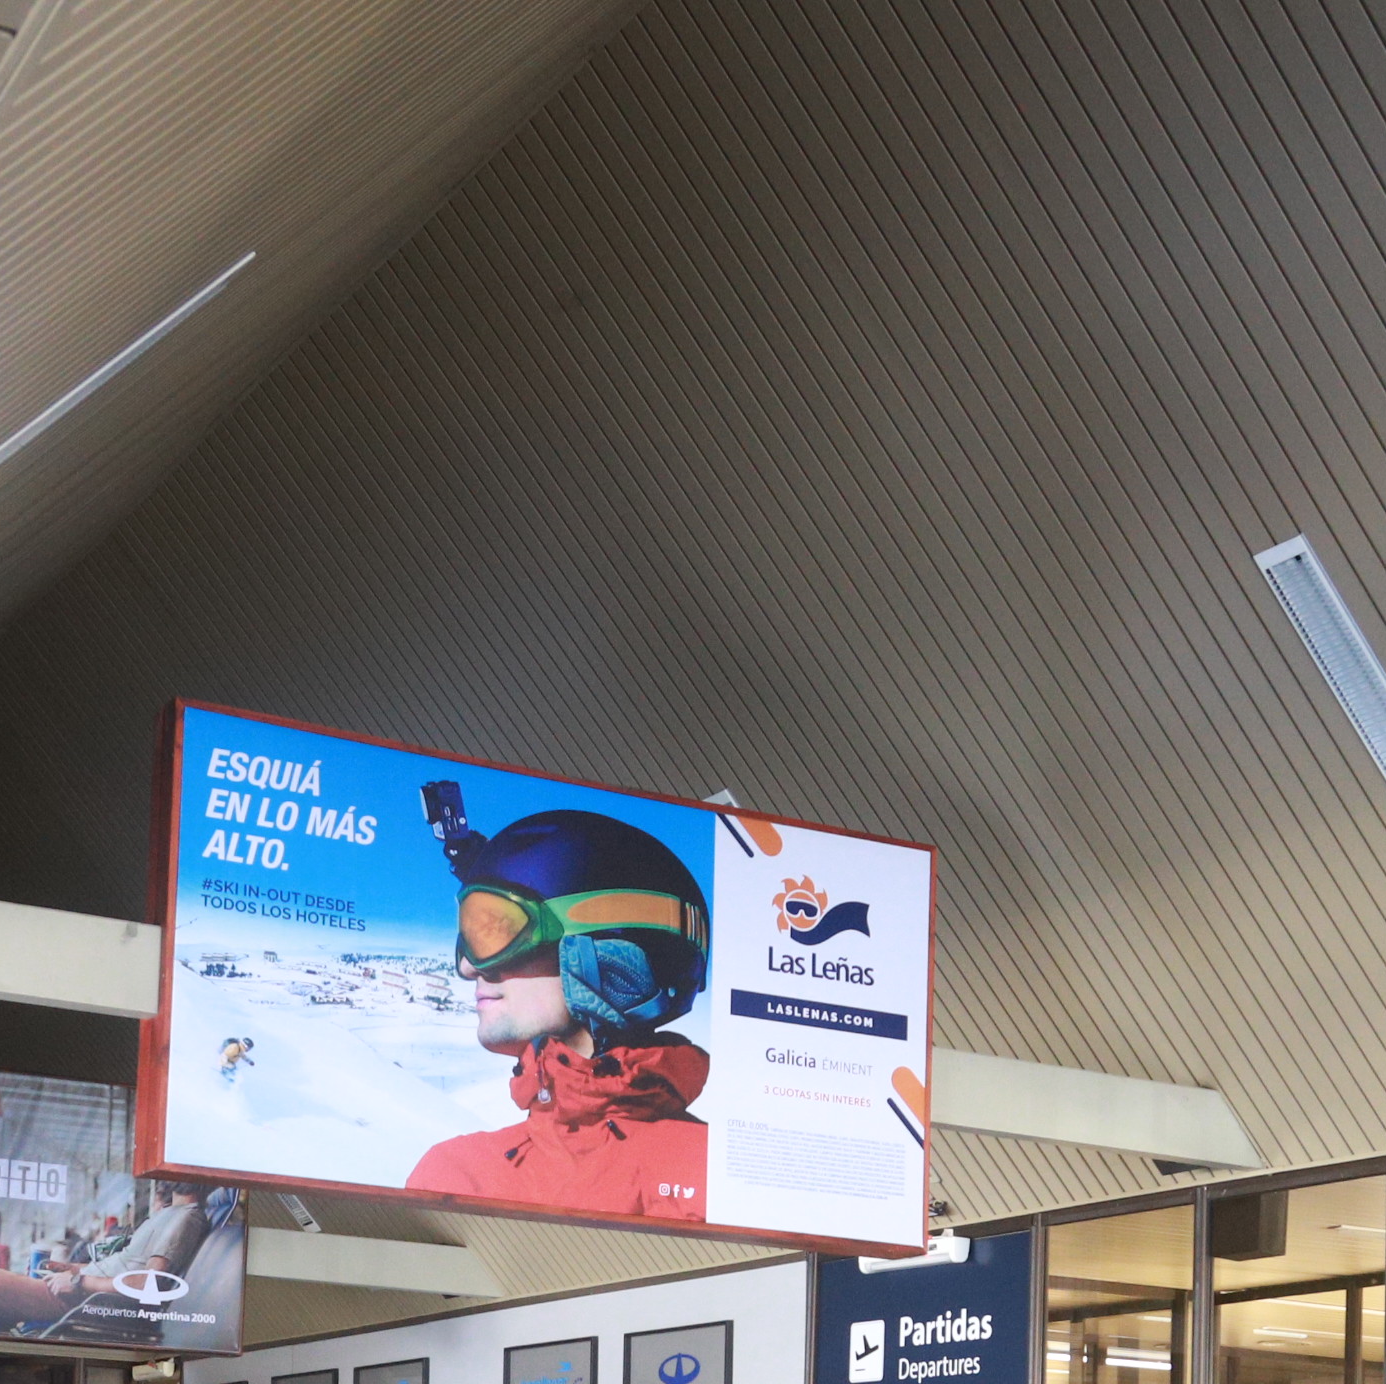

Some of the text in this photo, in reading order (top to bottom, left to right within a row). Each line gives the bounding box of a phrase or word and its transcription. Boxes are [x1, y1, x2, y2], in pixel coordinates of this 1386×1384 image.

[206, 747, 322, 798] ESQUIÁ
[205, 788, 378, 846] EN LO MÁS
[202, 829, 290, 871] ALTO.
[201, 893, 366, 932] TODOS LOS HOTELES
[202, 877, 355, 914] #SKI IN-OUT DESDE
[768, 946, 875, 986] Las Leñas
[767, 1002, 874, 1028] LASLENAS.COM
[765, 1047, 874, 1077] Galicia ÉMINENT
[764, 1085, 872, 1108] 3 CUOTAS SIN INTERÉS
[82, 1304, 216, 1324] Aeropuertos Argentina 2000
[899, 1308, 992, 1347] Partidas
[898, 1356, 981, 1384] Departures
